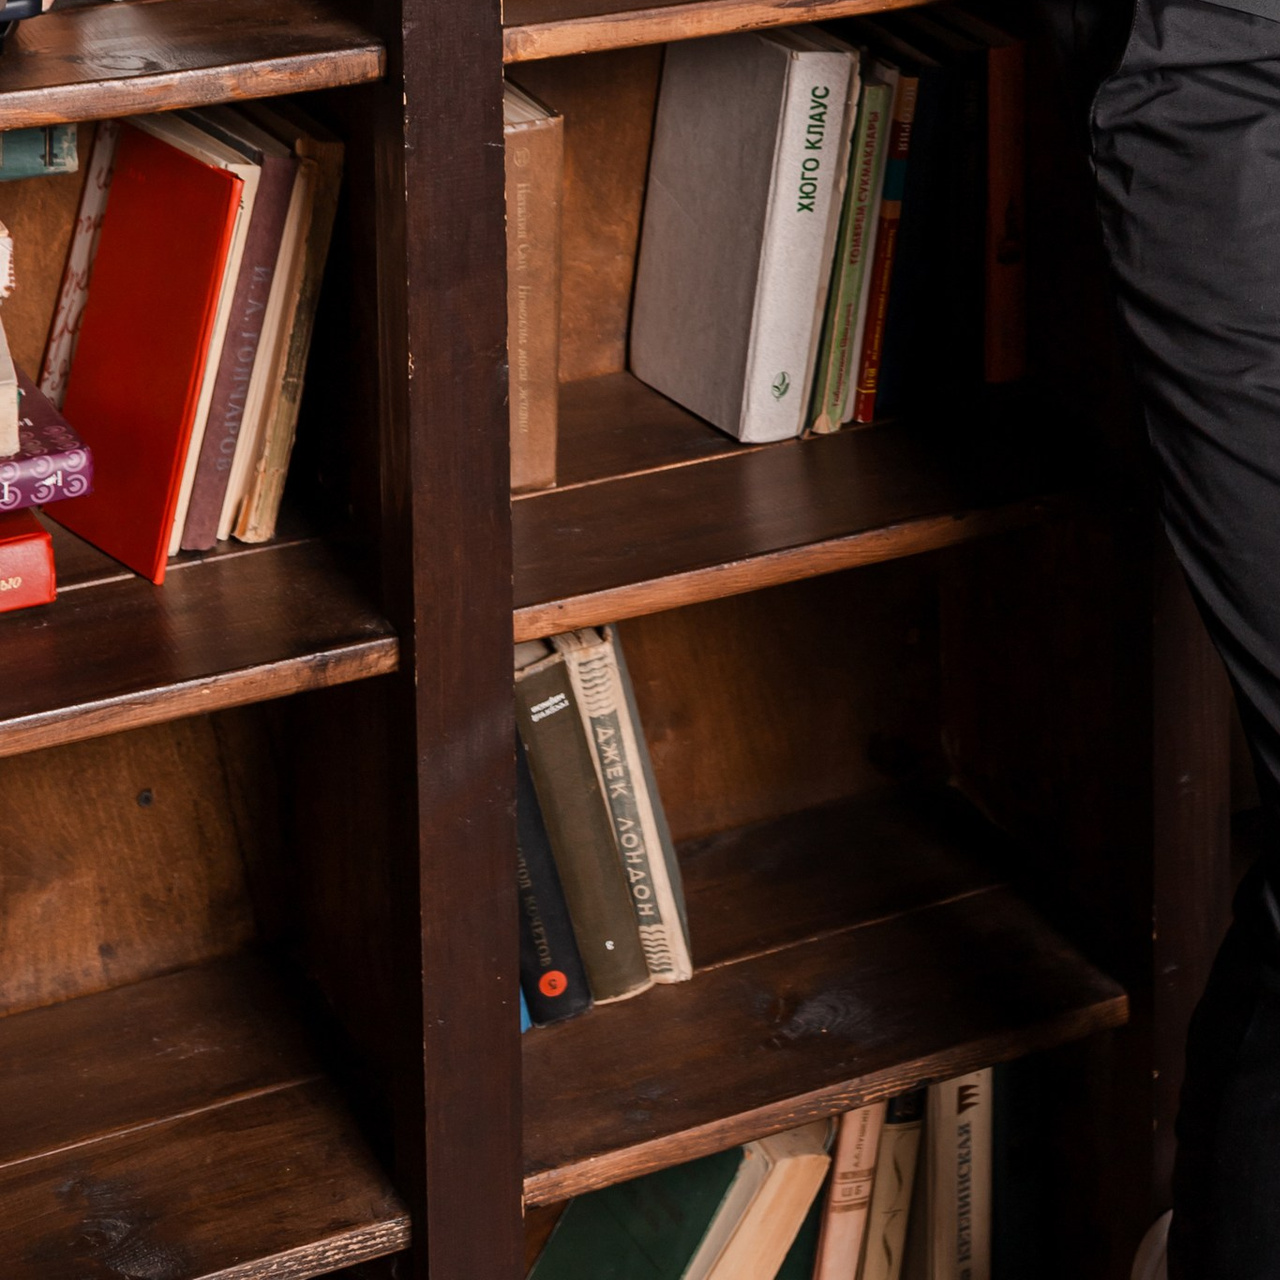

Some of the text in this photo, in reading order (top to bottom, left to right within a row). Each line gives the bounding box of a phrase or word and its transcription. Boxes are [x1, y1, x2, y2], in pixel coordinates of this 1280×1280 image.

[797, 85, 831, 213] ХЮГО КЛАУС
[216, 332, 260, 472] ГОНЧАРОВ
[595, 725, 655, 918] ДЖЕК ЛОНДОН
[523, 893, 550, 968] КОЧЕТОВ
[955, 1120, 973, 1269] КЕТЛИНСКАЯ
